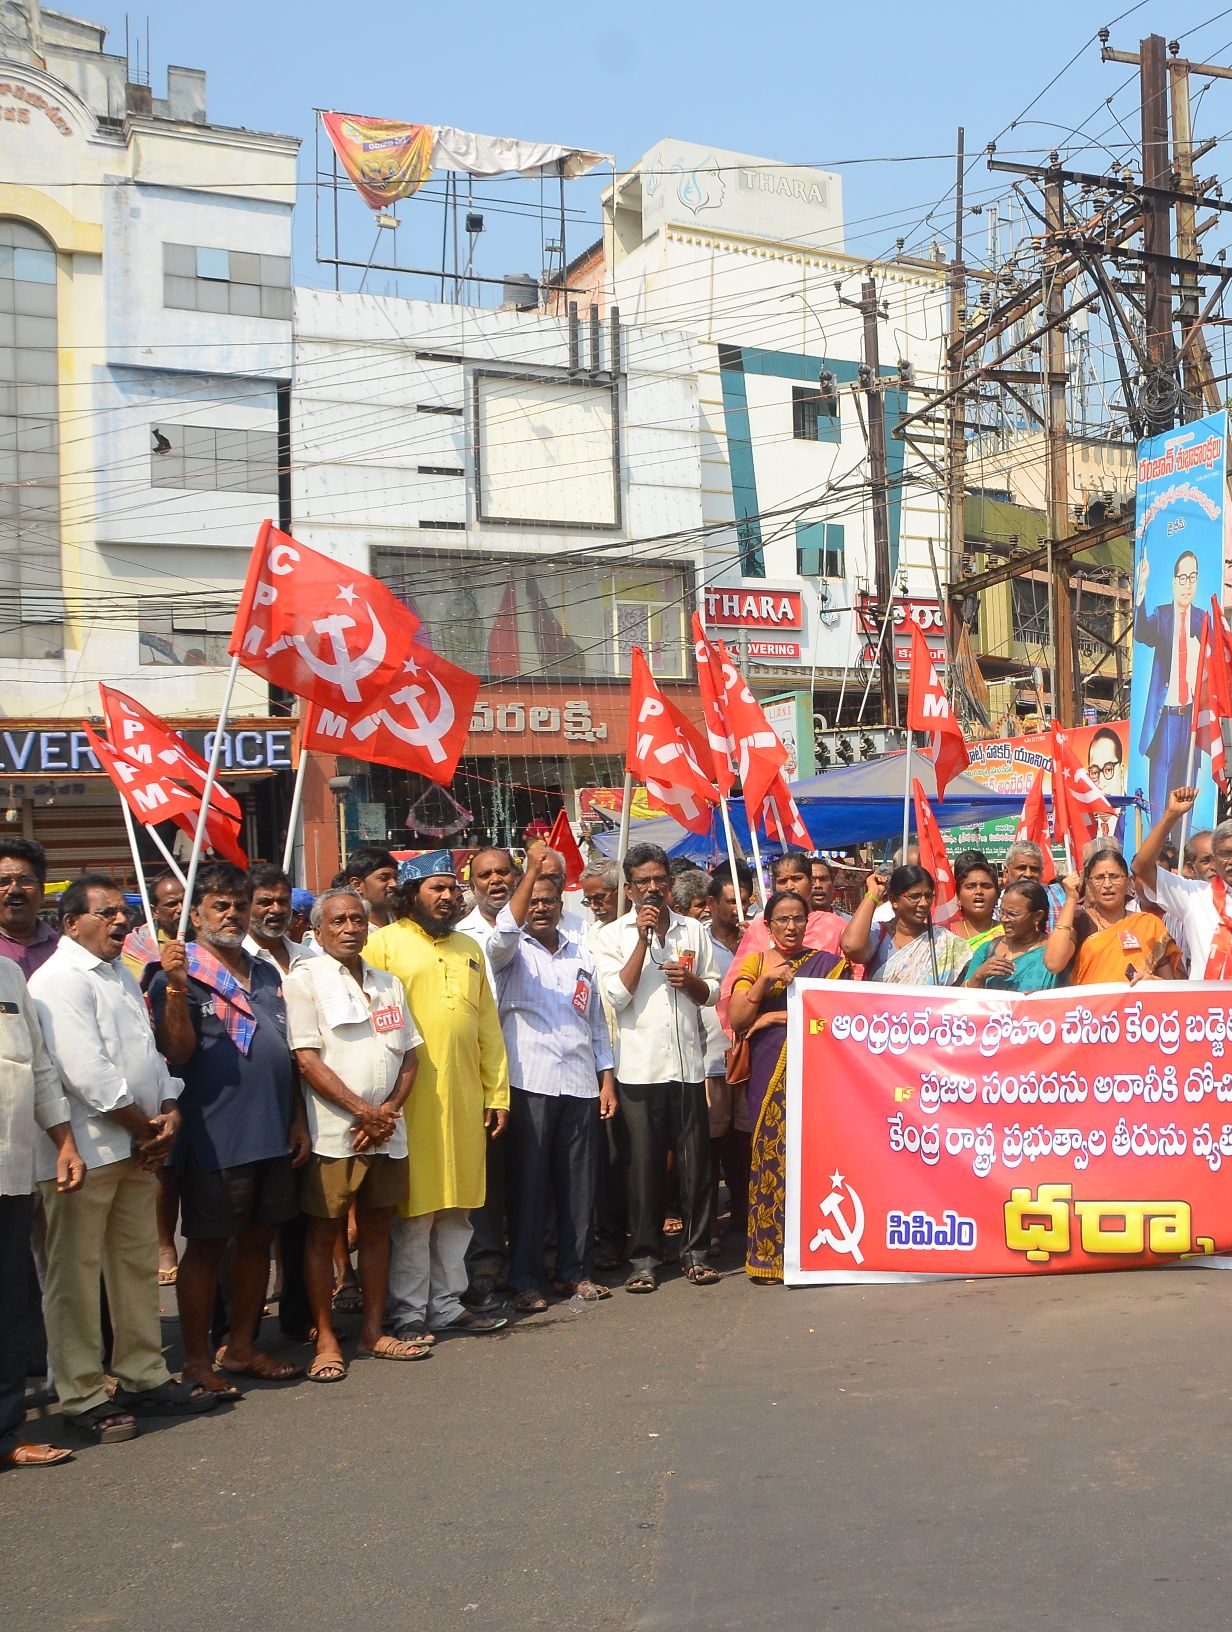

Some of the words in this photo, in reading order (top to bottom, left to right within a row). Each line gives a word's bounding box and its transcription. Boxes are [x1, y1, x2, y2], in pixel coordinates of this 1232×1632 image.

[742, 168, 825, 205] THARA
[704, 593, 796, 623] THARA
[0, 731, 101, 771] VER
[376, 1012, 400, 1027] CITU
[979, 1011, 1056, 1058] ద్రోహం
[1060, 1004, 1120, 1045] చేసిన
[1124, 1000, 1180, 1055] కేంద్ర
[919, 1070, 977, 1114] ప్రజల
[981, 1070, 1089, 1105] సంపదను
[1093, 1065, 1179, 1104] అదానీకి
[887, 1114, 941, 1166] కేంద్ర
[944, 1122, 996, 1178] రాష్ట్ర
[1001, 1119, 1108, 1170] ప్రభుత్వాల
[1111, 1117, 1188, 1158] తీరును
[887, 1211, 975, 1250] సిపిఎం
